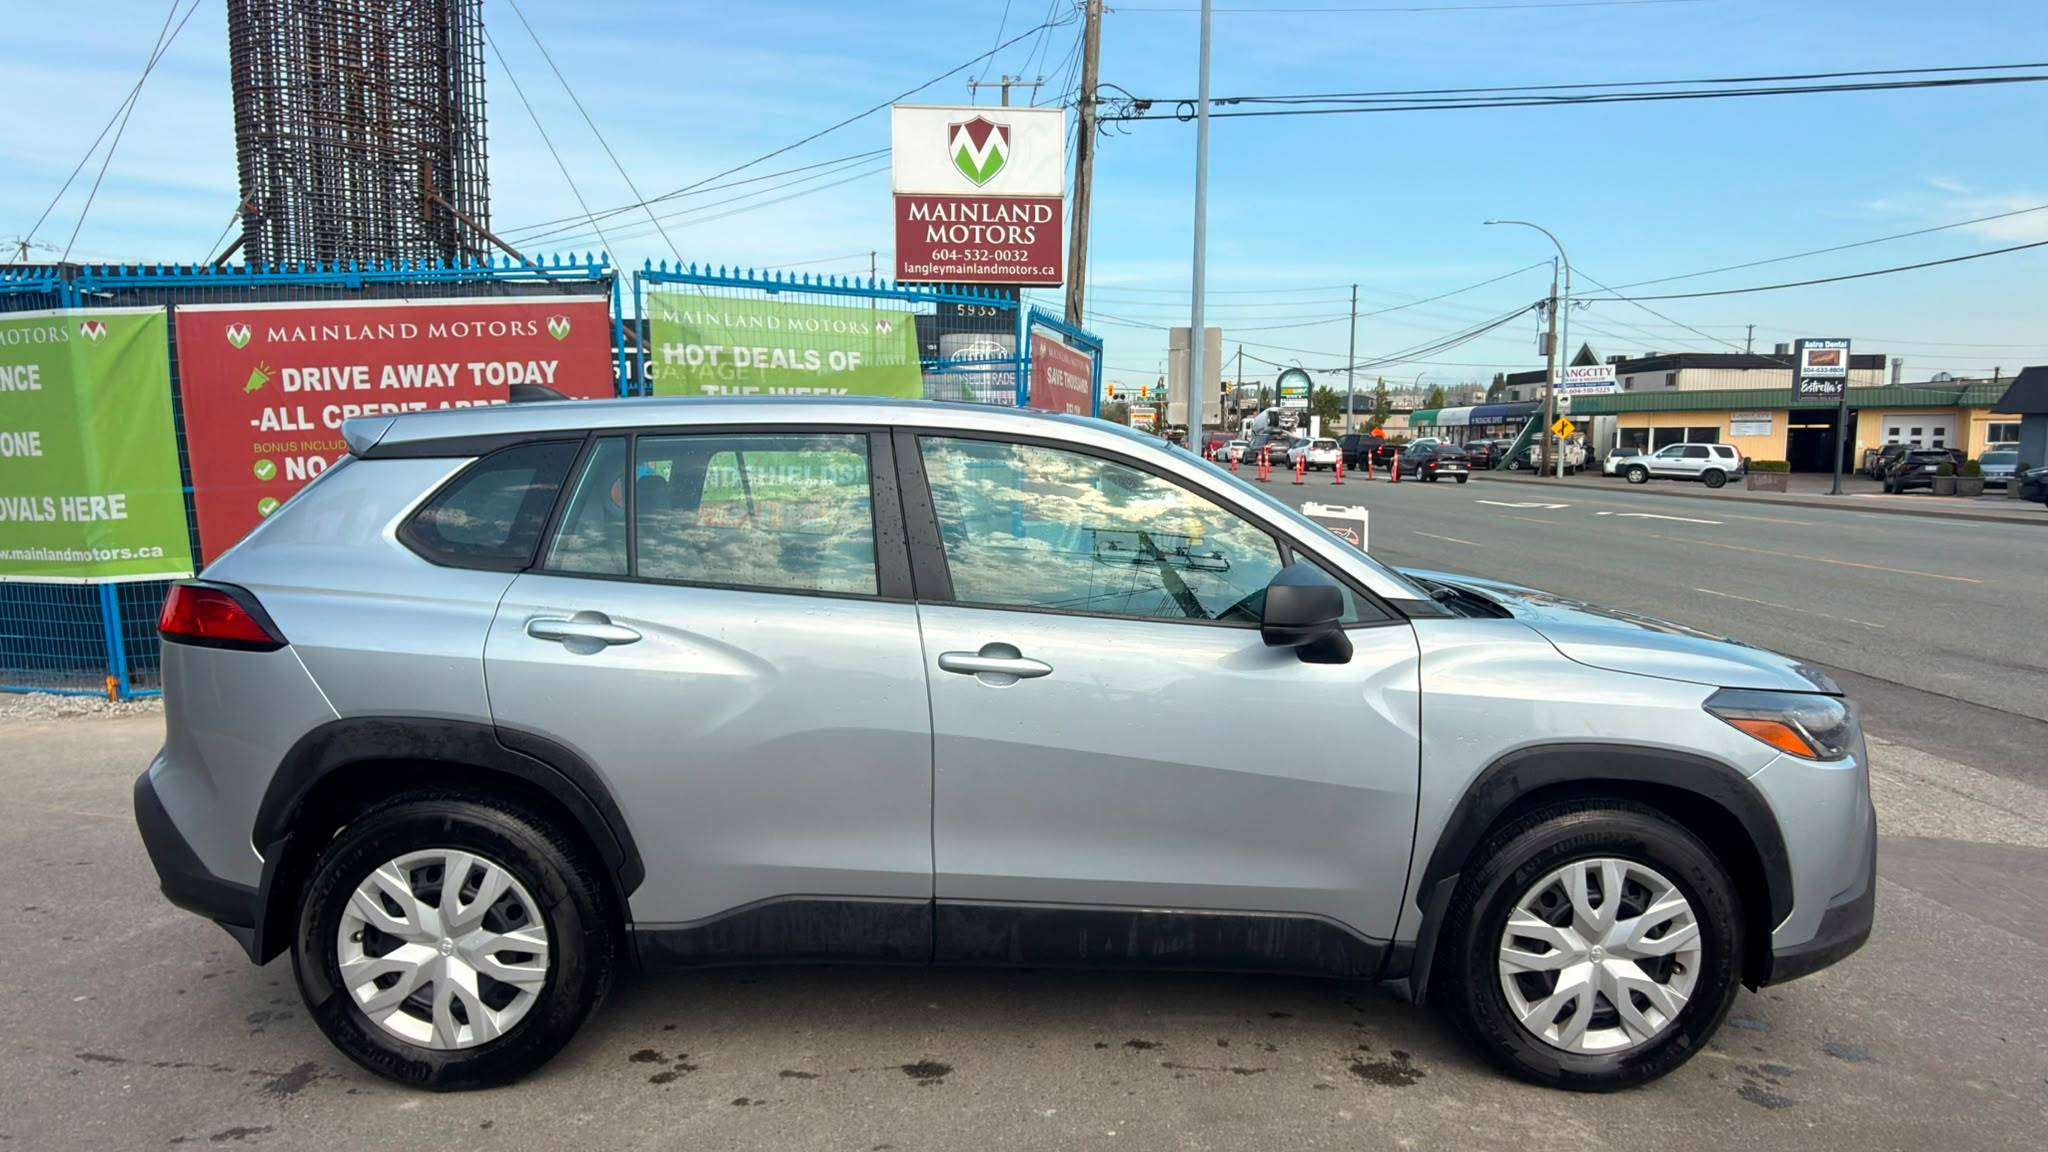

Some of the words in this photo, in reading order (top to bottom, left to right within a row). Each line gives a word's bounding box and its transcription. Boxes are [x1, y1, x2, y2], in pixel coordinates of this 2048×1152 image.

[908, 202, 1053, 223] MAINLAND
[926, 224, 1036, 245] MOTORS
[931, 249, 1029, 262] 604-532-0032
[904, 262, 1055, 276] langleymainlandmotors.ca
[267, 323, 418, 343] MAINLAND
[428, 320, 538, 338] MOTORS
[663, 309, 780, 331] MAINLAND
[787, 318, 869, 335] MOTORS
[663, 342, 723, 367] HOT
[734, 346, 821, 371] DEALS
[828, 351, 862, 372] OF
[281, 365, 371, 393] DRIVE
[380, 363, 460, 389] AWAY
[467, 360, 559, 386] TODAY
[250, 406, 315, 432] -ALL
[254, 441, 298, 453] BONUS
[300, 439, 349, 452] INCLUD
[284, 455, 328, 481] NO
[60, 493, 128, 522] HERE
